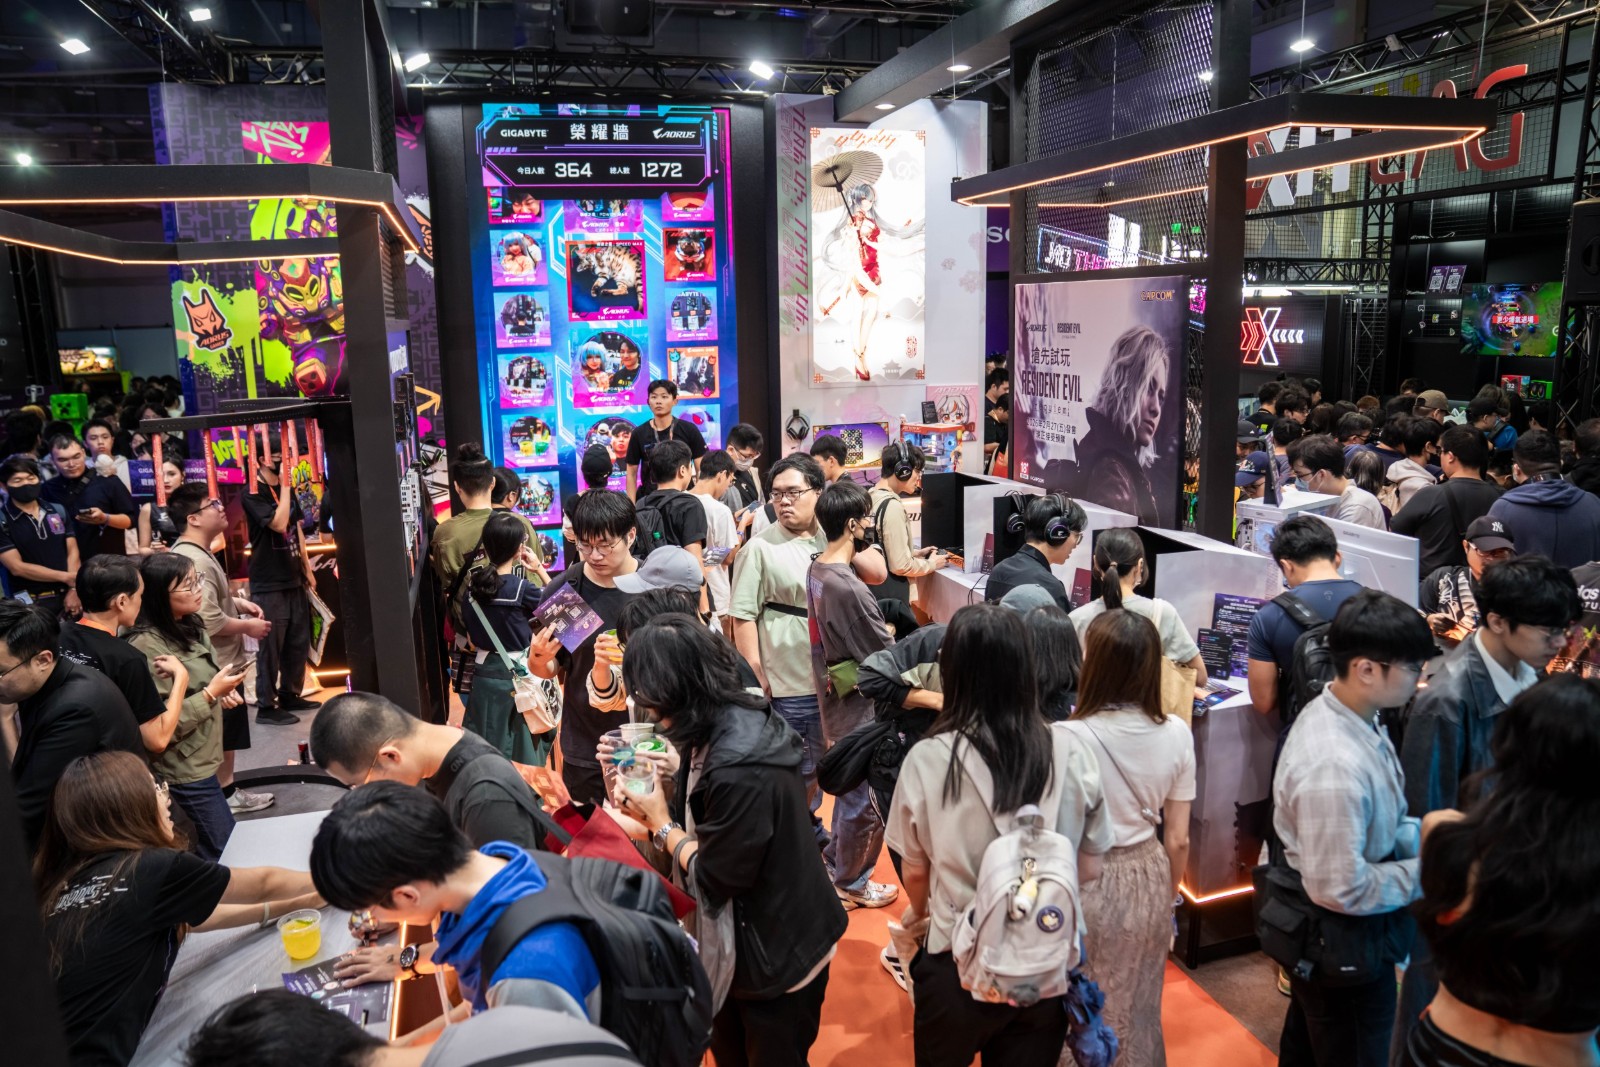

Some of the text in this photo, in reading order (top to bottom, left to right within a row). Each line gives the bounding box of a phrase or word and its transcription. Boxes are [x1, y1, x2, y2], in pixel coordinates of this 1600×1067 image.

[500, 128, 547, 138] GIGABYTE
[661, 129, 697, 139] AORUS
[517, 162, 593, 178] 今日人數 364
[641, 162, 683, 178] 1272
[1140, 290, 1173, 301] CAPCOM
[1057, 322, 1081, 334] RESIDENT EVIL
[200, 330, 230, 347] AORUS
[1031, 347, 1071, 367] 搶先試玩
[1021, 370, 1083, 402] RESIDENT EVIL
